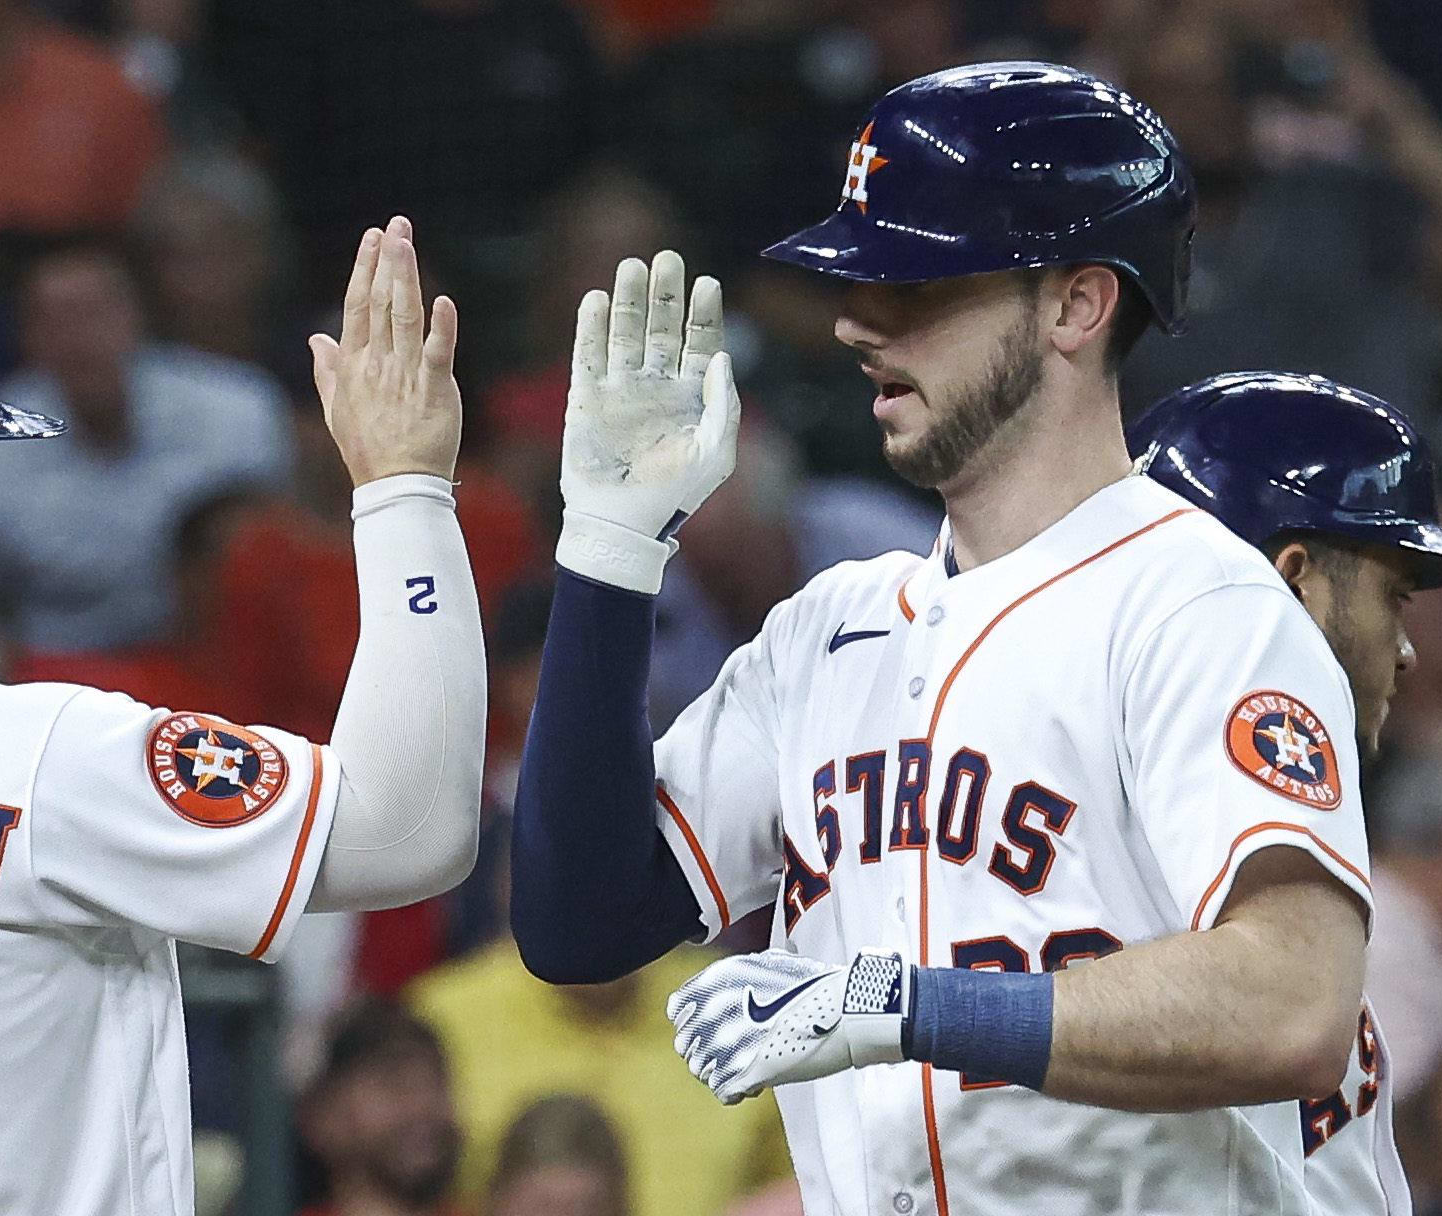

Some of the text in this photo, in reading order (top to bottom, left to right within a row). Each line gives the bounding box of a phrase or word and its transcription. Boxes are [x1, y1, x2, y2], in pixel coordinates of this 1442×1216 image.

[842, 141, 877, 202] H
[406, 576, 438, 614] 2
[1237, 696, 1328, 744] HOUSTON
[155, 716, 200, 800] HOUSTON
[192, 737, 244, 785] H
[242, 740, 281, 812] ASTROS
[1269, 725, 1316, 776] H
[1256, 765, 1335, 801] ASTROS
[783, 738, 1078, 939] ASTROS
